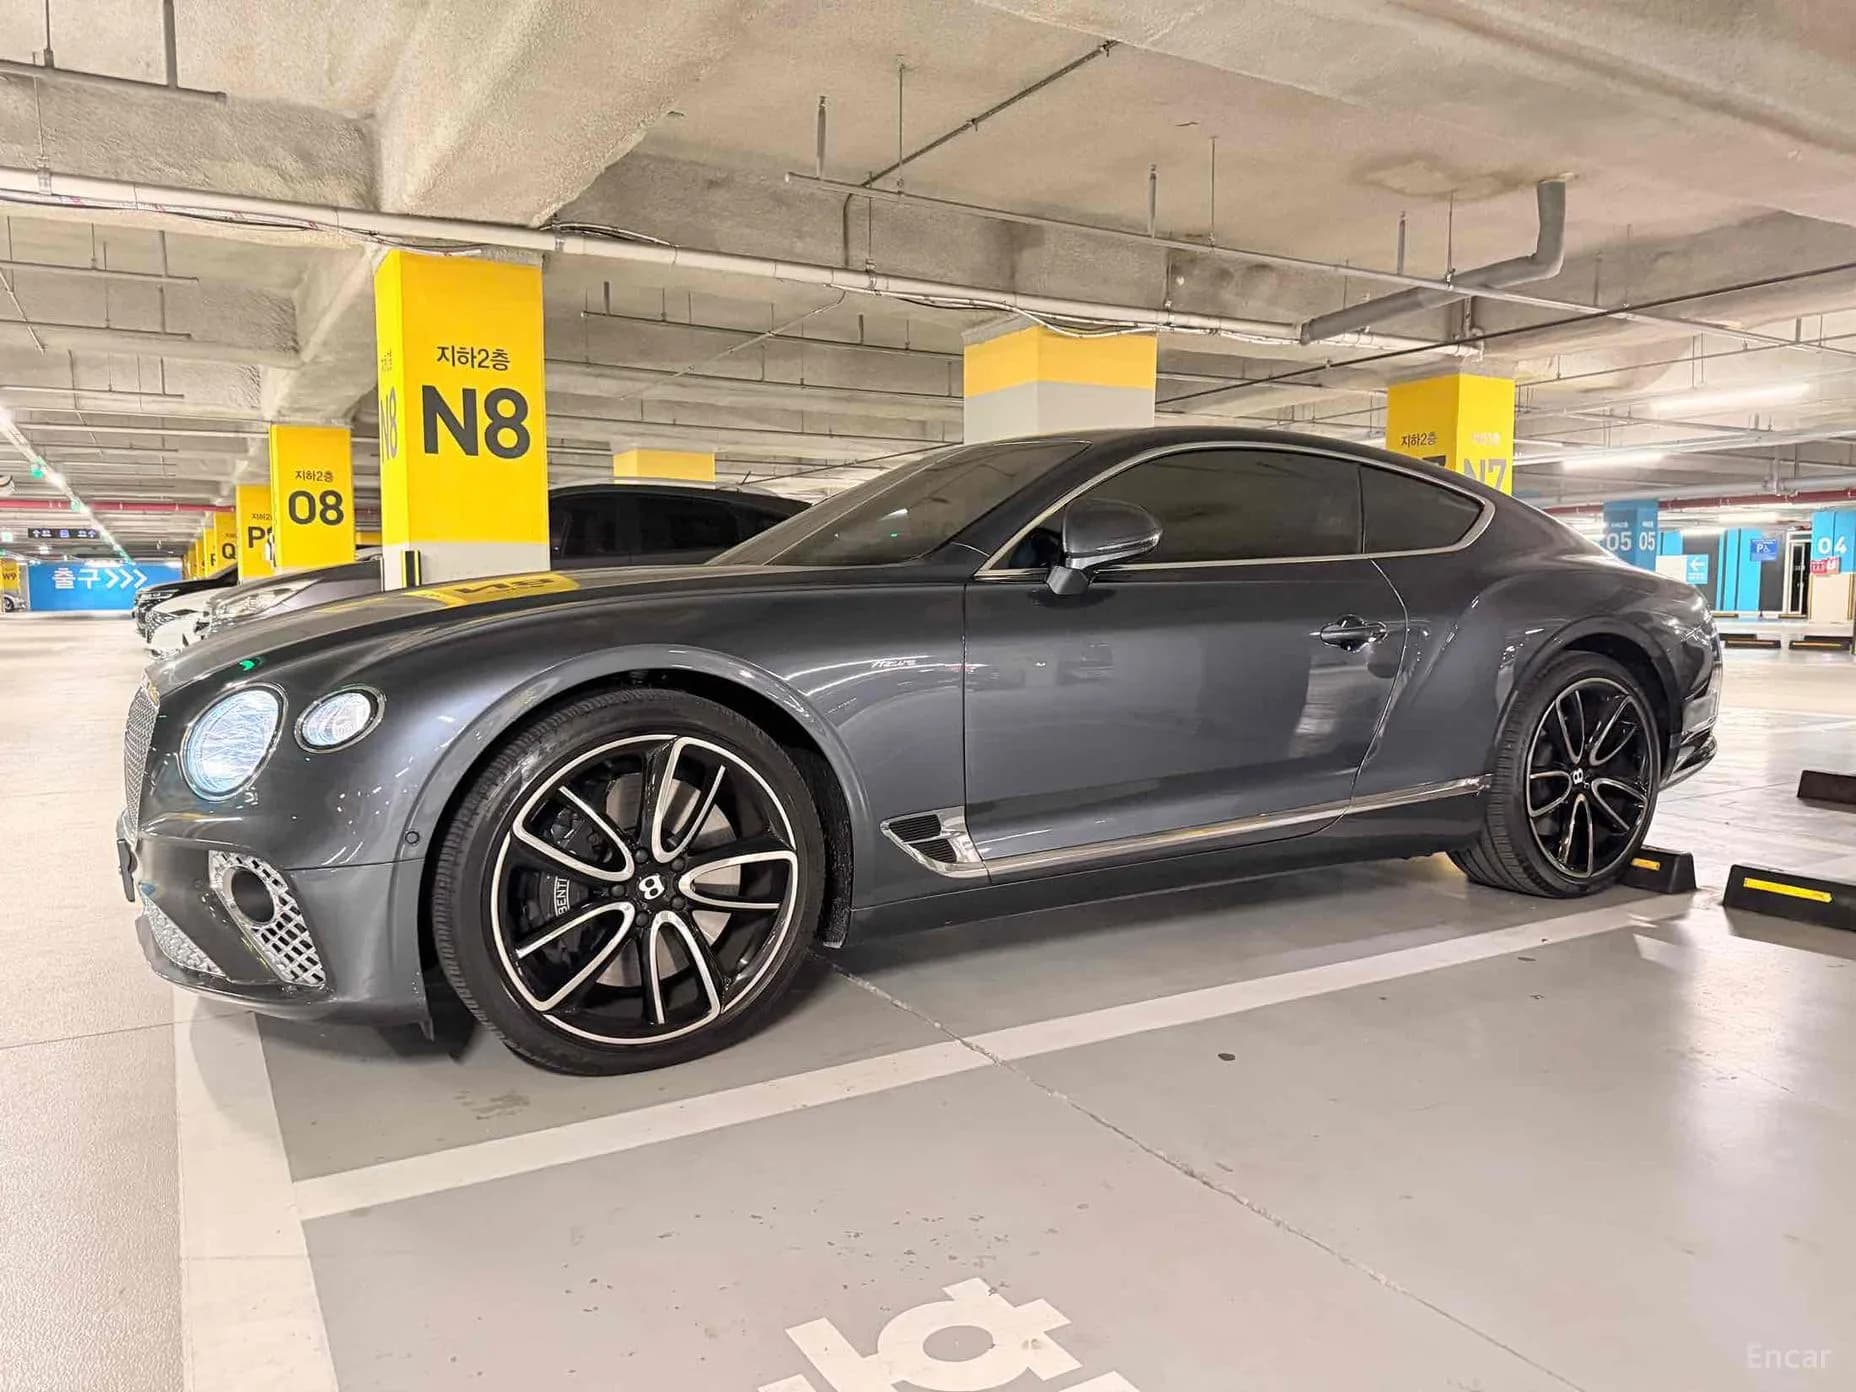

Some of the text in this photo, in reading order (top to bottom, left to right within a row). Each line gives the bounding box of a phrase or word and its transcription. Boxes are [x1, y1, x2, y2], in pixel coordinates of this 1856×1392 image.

[437, 345, 511, 372] 지하2층
[380, 386, 398, 464] N8
[422, 385, 531, 460] N8
[1401, 431, 1437, 448] 지하2층
[295, 470, 334, 483] 지하2층
[1463, 457, 1508, 492] N7
[251, 513, 273, 521] 지하2
[51, 567, 101, 589] 출구
